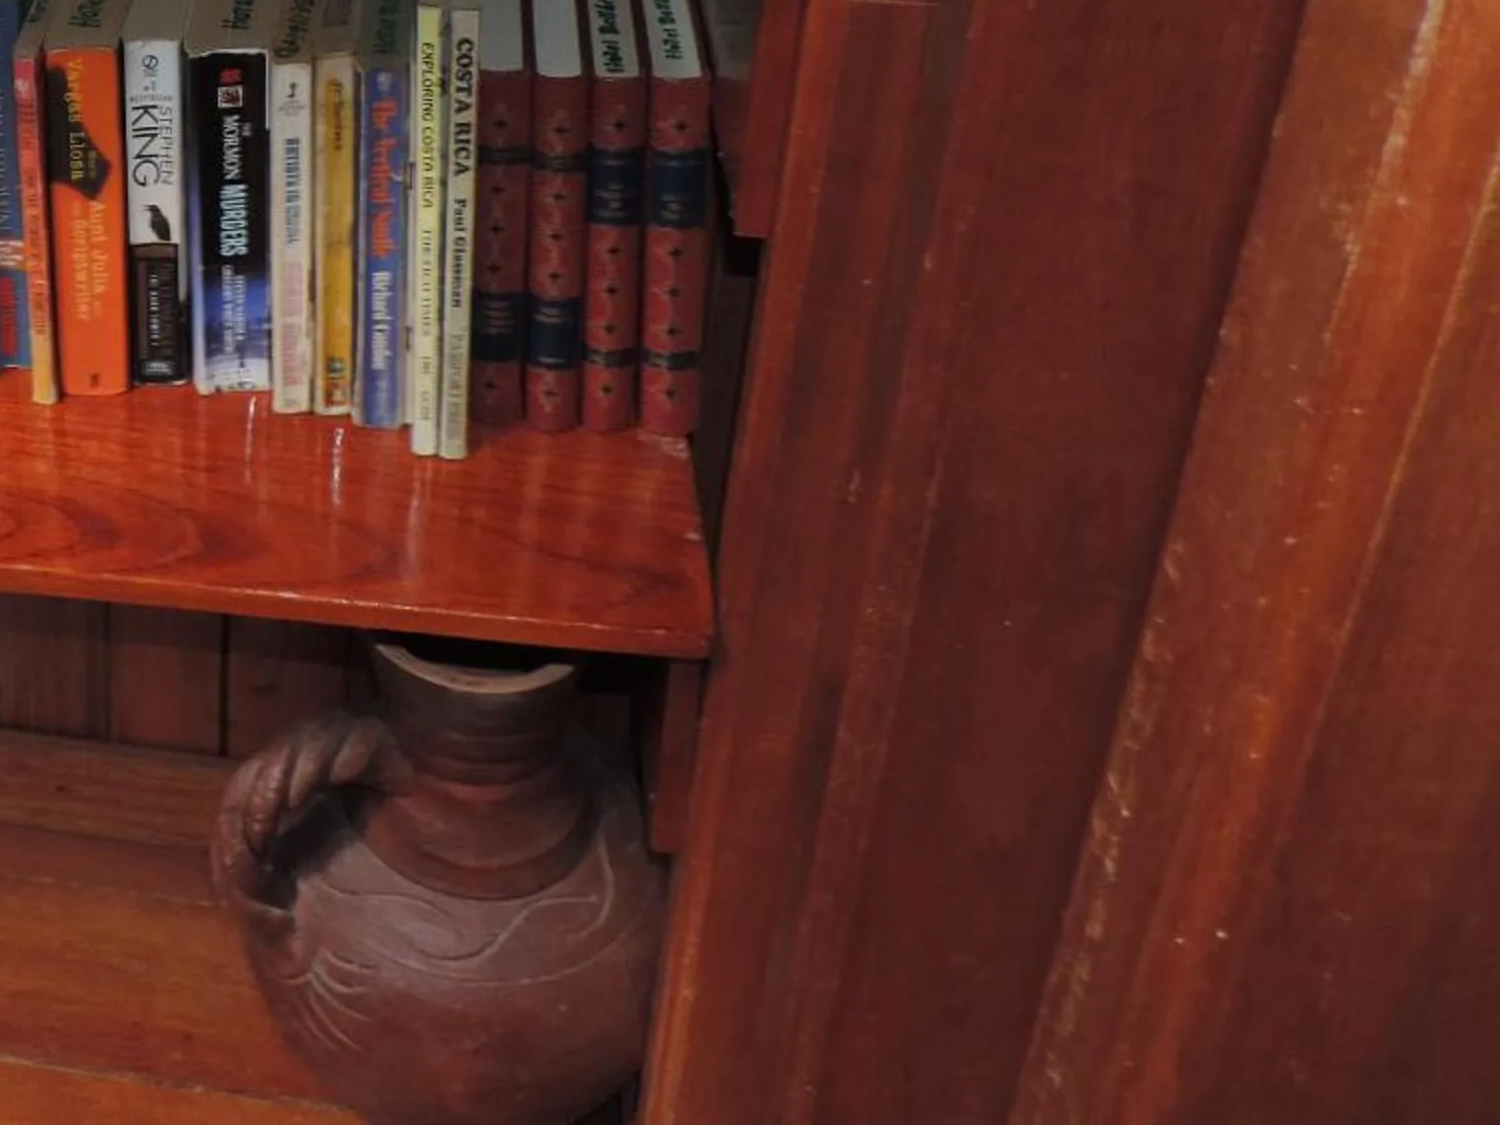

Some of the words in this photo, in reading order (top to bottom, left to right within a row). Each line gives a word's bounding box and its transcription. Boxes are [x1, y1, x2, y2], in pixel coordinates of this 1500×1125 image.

[60, 58, 84, 123] Vargas
[420, 42, 435, 121] EXPLORING
[453, 37, 474, 114] COSTA
[67, 131, 87, 180] Llosa
[127, 104, 161, 188] KING
[156, 105, 175, 185] STEPHEN
[220, 115, 241, 179] MORMON
[421, 126, 434, 171] COSTA
[453, 121, 471, 176] RICA
[88, 200, 106, 243] Aunt
[217, 184, 248, 256] MURDERS
[421, 176, 435, 208] RICA
[452, 199, 468, 231] Paul
[70, 219, 91, 322] Scriptwriter
[90, 249, 108, 293] Julia
[371, 271, 393, 320] Richard
